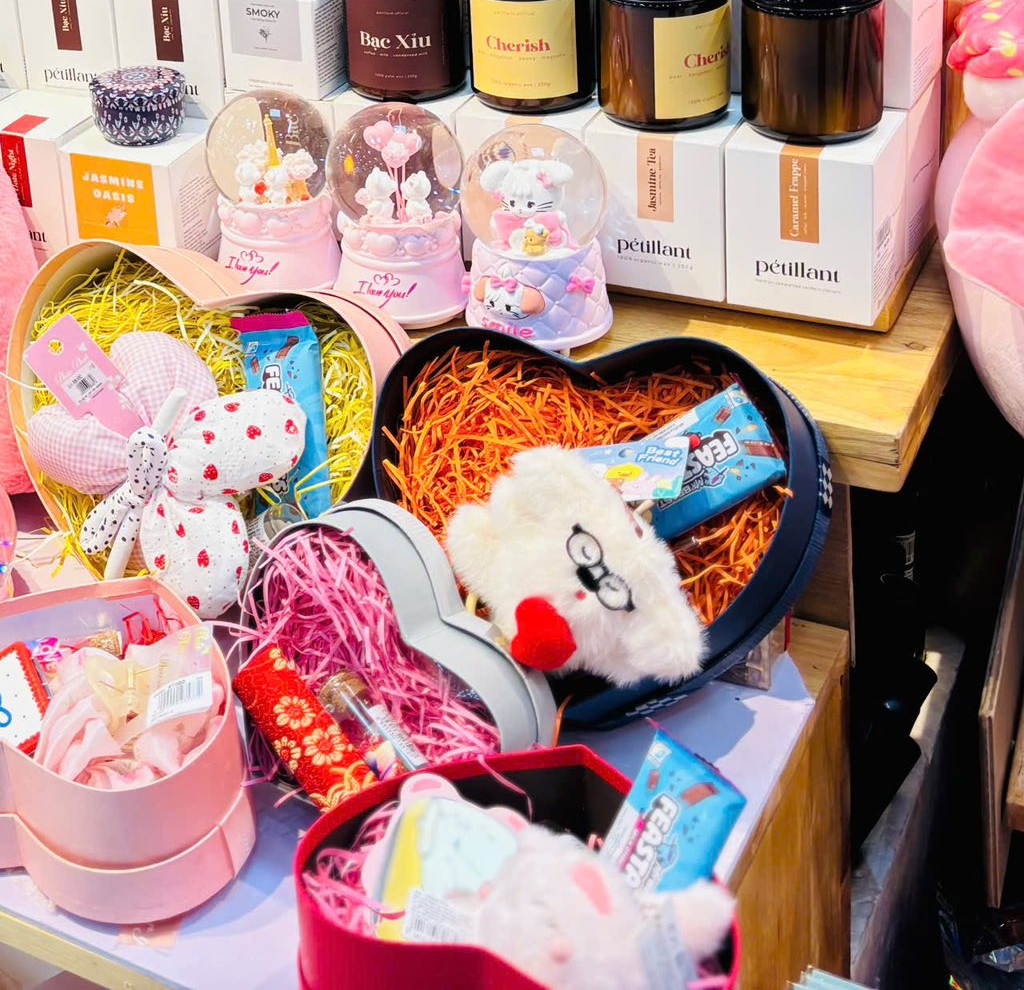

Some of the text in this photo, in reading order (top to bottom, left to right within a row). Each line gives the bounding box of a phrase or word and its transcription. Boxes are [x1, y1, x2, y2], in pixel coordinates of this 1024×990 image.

[246, 7, 280, 19] SMOKY
[360, 30, 391, 51] Bạc
[486, 34, 552, 52] Cherish
[44, 62, 98, 83] pétillan
[81, 172, 145, 189] JASMINE
[647, 148, 657, 212] Jasmine Tea
[92, 189, 136, 204] OASIS
[789, 194, 800, 237] Caramel
[617, 238, 692, 260] pétillant
[755, 260, 841, 284] pétillant
[637, 454, 681, 467] Friend
[646, 446, 681, 459] Best
